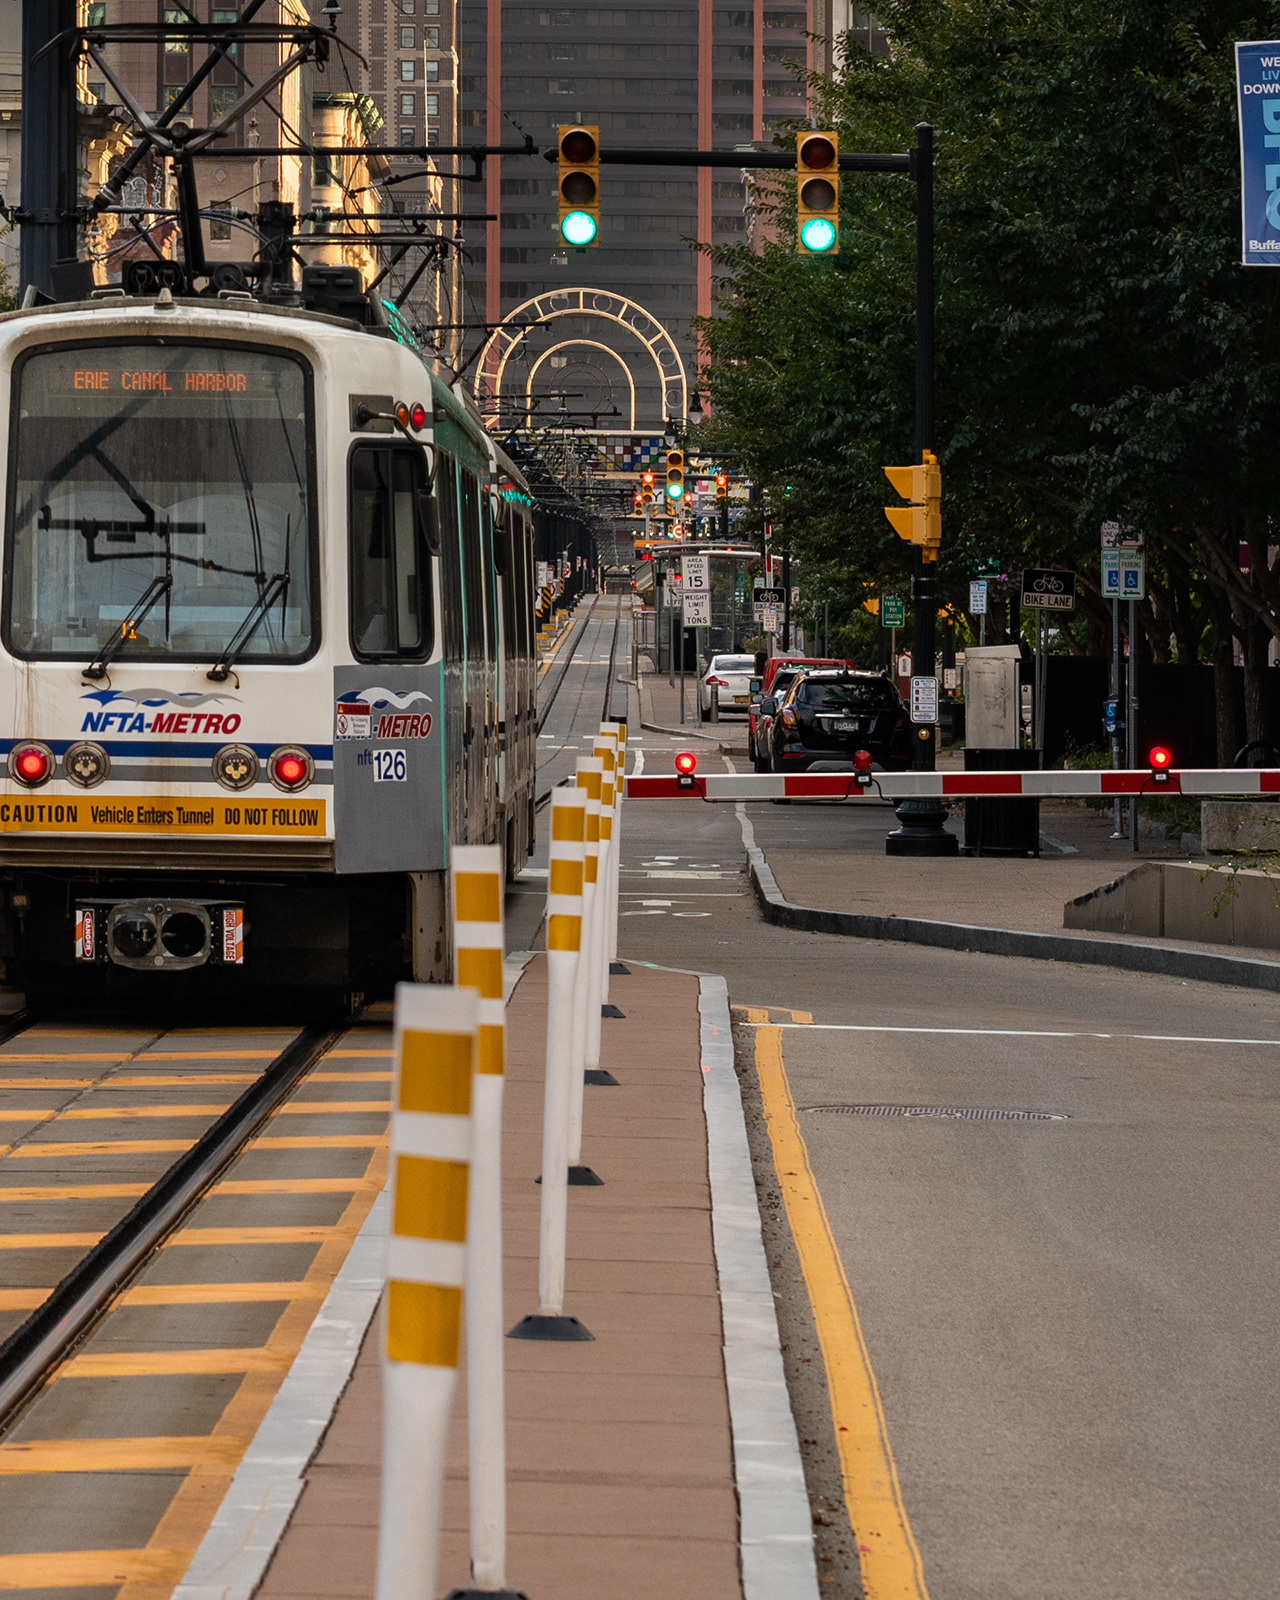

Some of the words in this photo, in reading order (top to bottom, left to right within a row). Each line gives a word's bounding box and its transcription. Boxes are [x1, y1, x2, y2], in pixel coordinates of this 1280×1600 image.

[74, 371, 109, 390] ERIE
[121, 371, 172, 391] CANAL
[185, 372, 247, 392] HARBOR
[688, 575, 703, 587] 15
[1025, 594, 1045, 606] BIKE
[1048, 596, 1071, 607] LANE
[81, 712, 241, 734] NFTA-METRO
[374, 751, 406, 780] 126
[1, 804, 77, 823] CAUTION
[91, 806, 134, 823] Vehicle
[137, 807, 173, 824] Enters
[176, 807, 214, 825] Tunnel
[224, 808, 240, 825] DO
[244, 809, 267, 825] NOT
[272, 809, 318, 826] FOLLOW
[225, 910, 235, 929] HIGH
[225, 931, 235, 961] VOLTAGE
